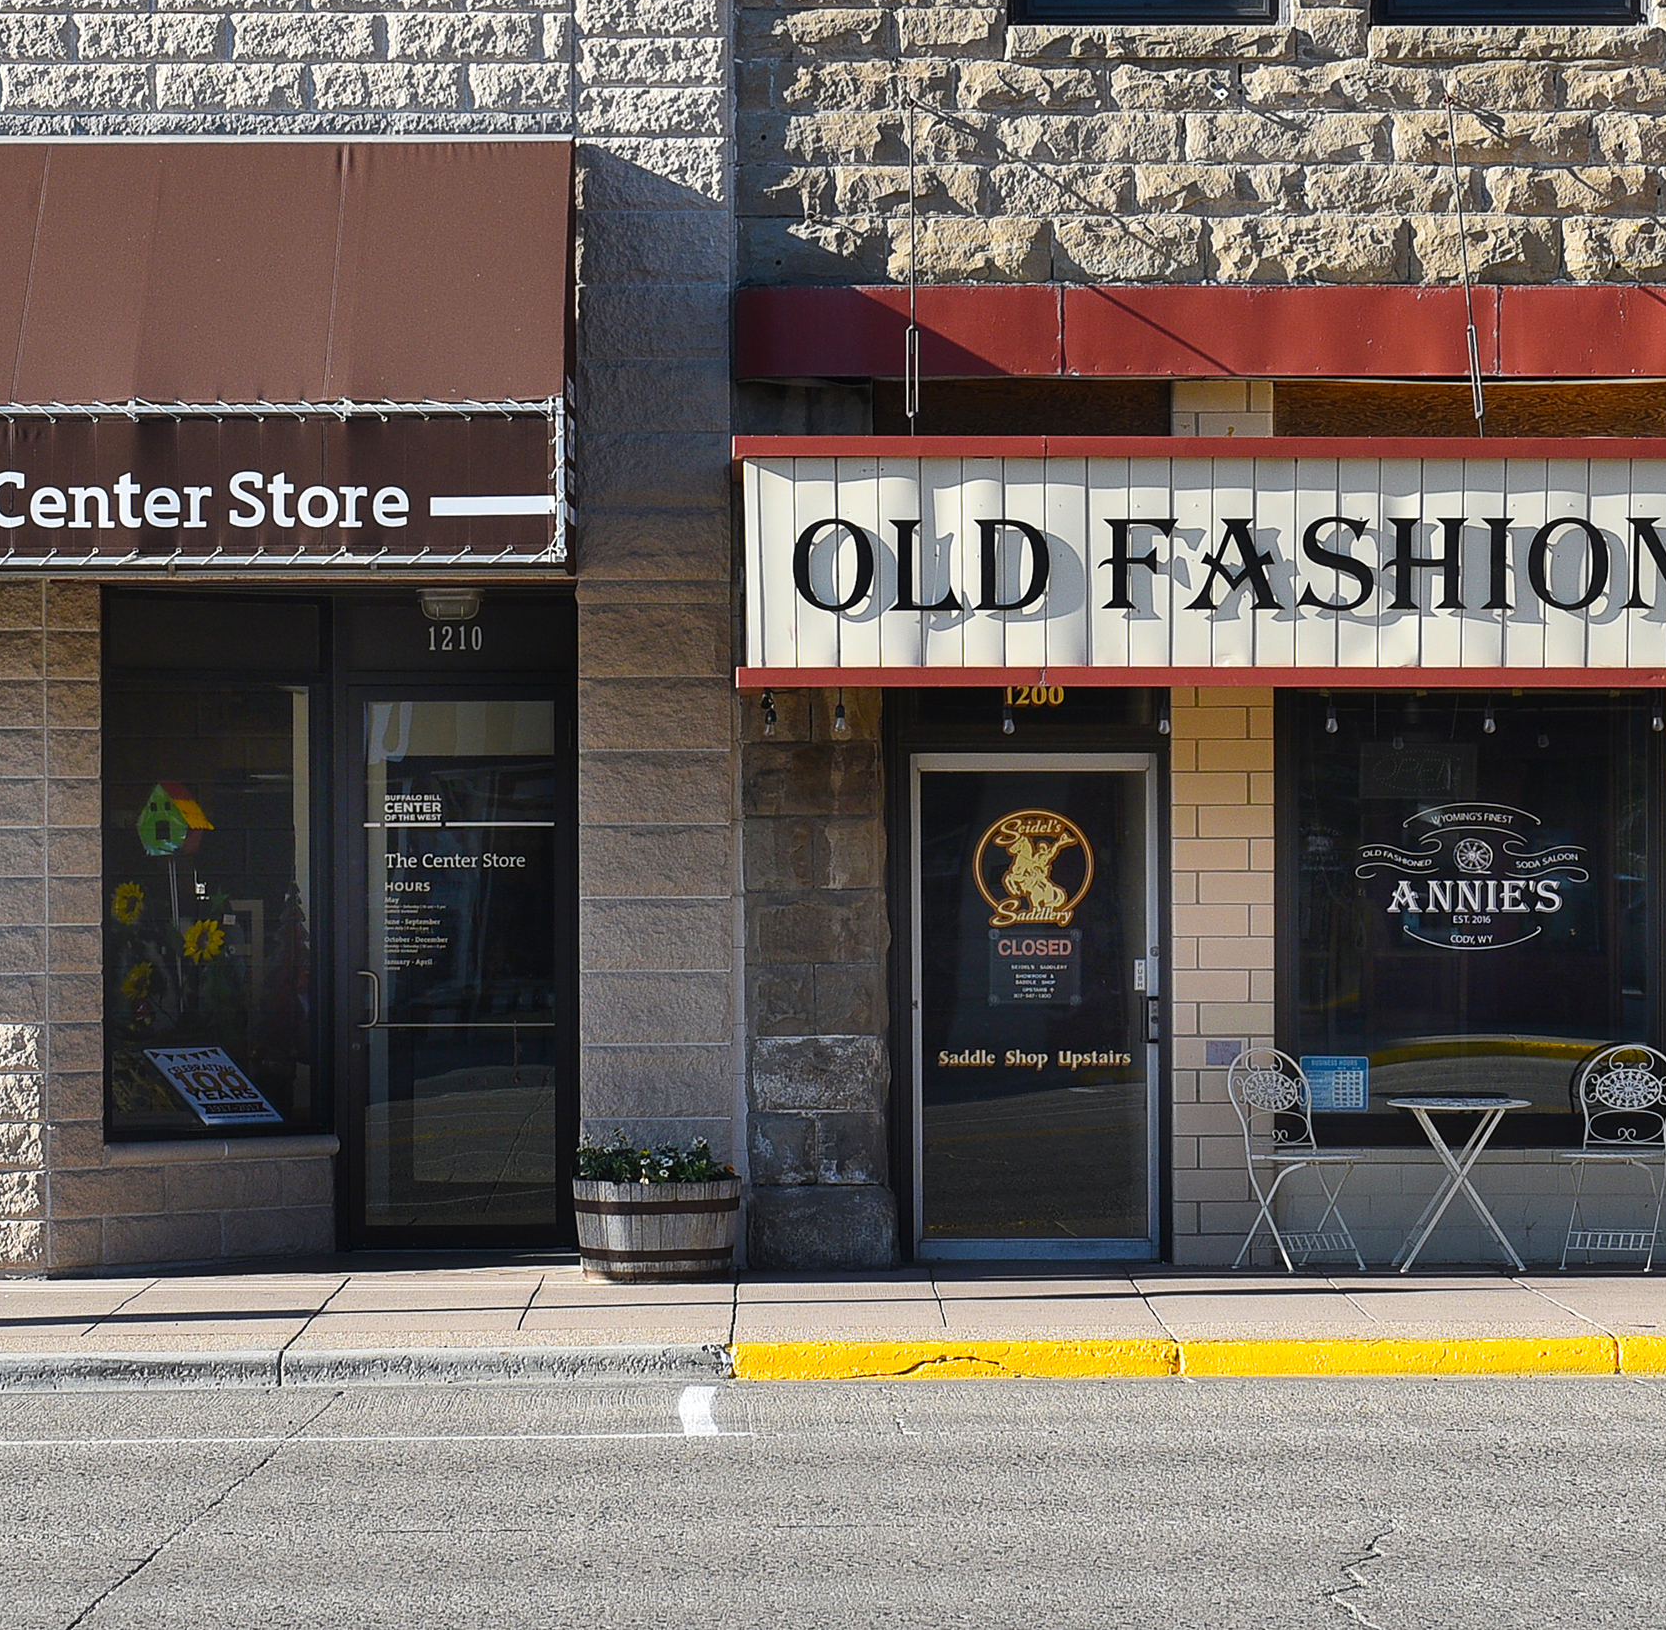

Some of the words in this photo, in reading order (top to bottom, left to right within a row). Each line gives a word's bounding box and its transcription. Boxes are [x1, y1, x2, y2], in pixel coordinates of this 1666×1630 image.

[228, 471, 410, 530] Store
[792, 516, 1050, 613] OLD
[429, 625, 483, 650] 1210
[1005, 686, 1065, 706] 1200
[384, 802, 441, 814] CENTER
[385, 814, 397, 822] OF
[1431, 812, 1483, 824] WYOMING'S
[1484, 813, 1513, 824] FINEST
[995, 818, 1061, 845] Seidel's
[385, 852, 417, 868] The
[422, 853, 479, 868] Center
[483, 852, 526, 868] Store
[1362, 849, 1382, 858] OLD
[1383, 850, 1432, 867] FASHIONED
[1515, 859, 1541, 870] SODA
[1542, 853, 1579, 867] SALOON
[385, 882, 431, 892] HOURS
[1386, 880, 1563, 914] ANNIE'S
[992, 900, 1071, 926] Saddlery
[1453, 915, 1471, 924] EST.
[1472, 915, 1491, 924] 2016
[405, 918, 441, 926] September
[997, 939, 1072, 956] CLOSED
[1450, 934, 1475, 945] CODY,
[1477, 934, 1493, 944] WY
[167, 1064, 236, 1074] CELEBRATING
[939, 1050, 996, 1067] Saddle
[1004, 1050, 1049, 1071] Shop
[1058, 1050, 1132, 1071] Upstairs
[173, 1071, 249, 1092] 100
[185, 1088, 259, 1100] YEARS
[207, 1104, 259, 1112] 1917-2017
